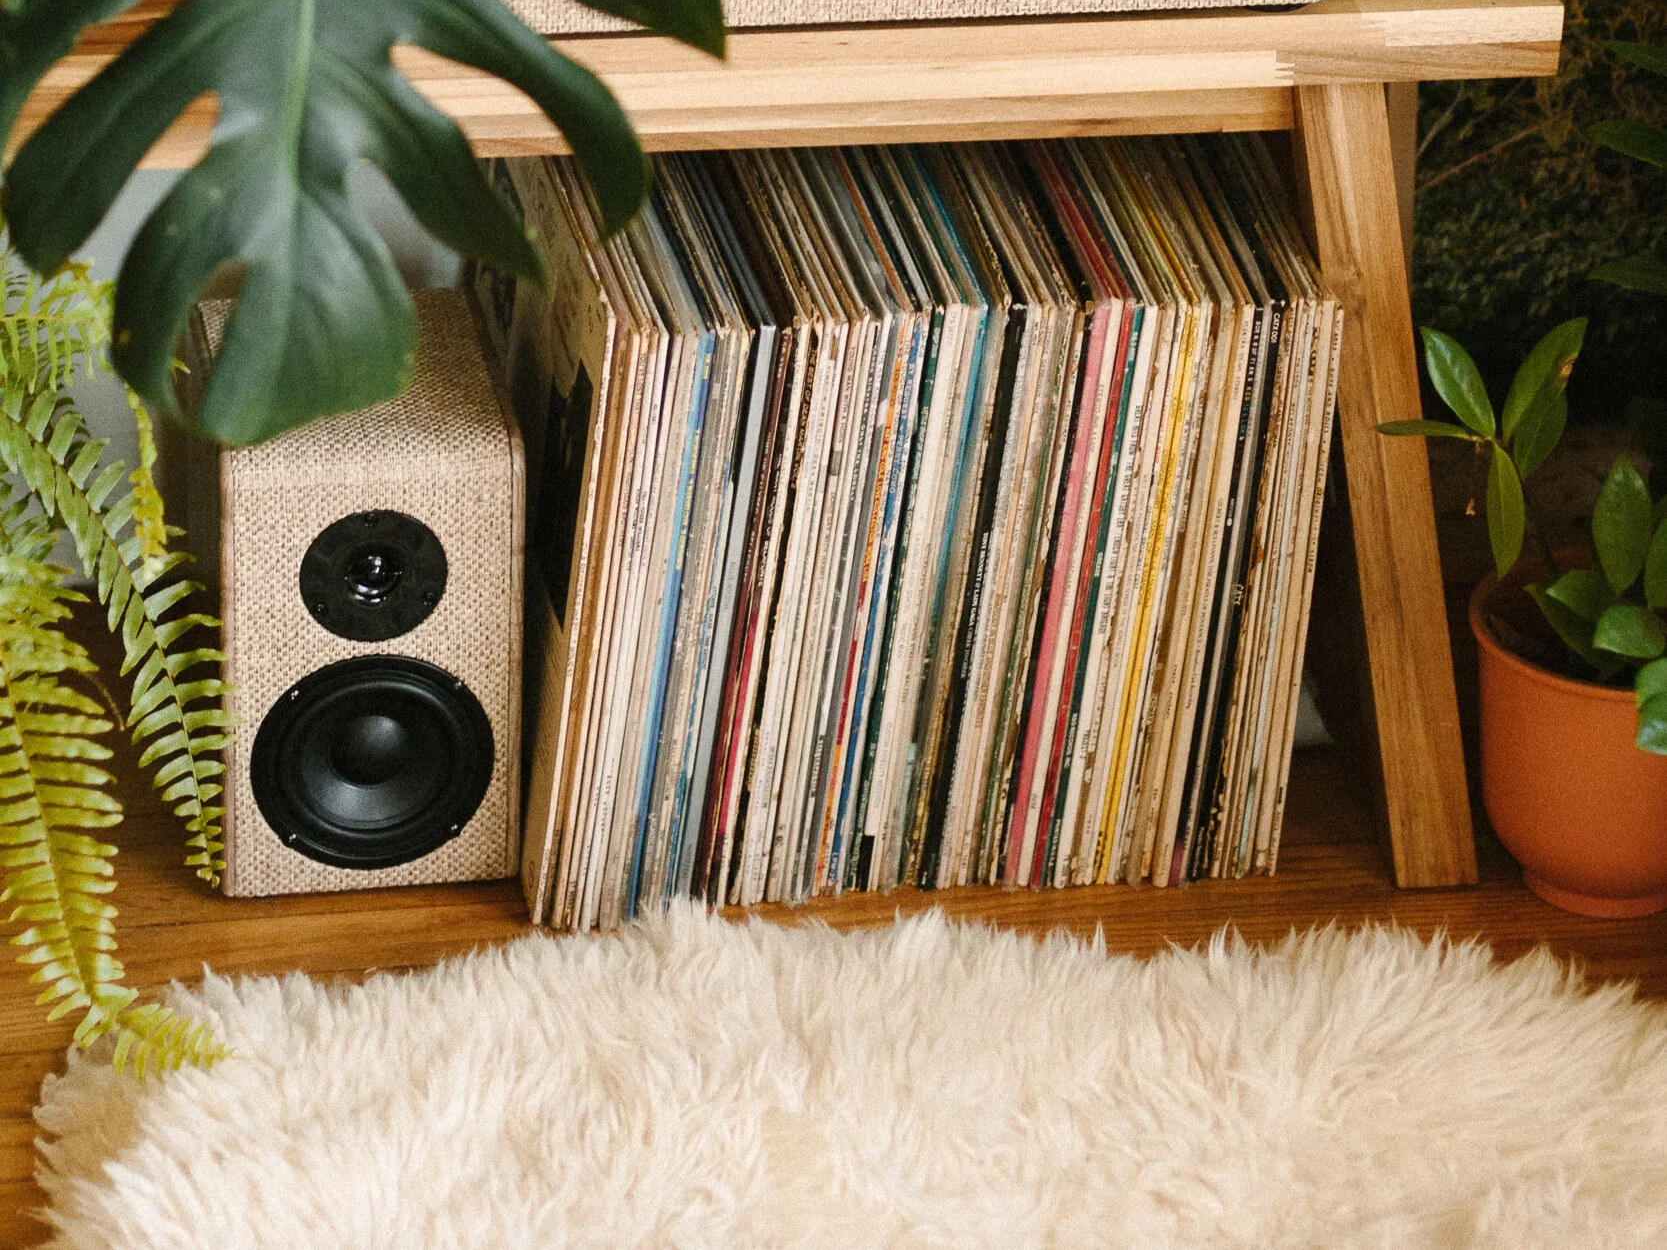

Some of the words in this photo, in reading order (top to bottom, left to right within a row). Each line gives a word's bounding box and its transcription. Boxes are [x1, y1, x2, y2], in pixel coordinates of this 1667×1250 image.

[1252, 320, 1260, 339] BORN
[1271, 313, 1280, 330] CATX
[847, 346, 855, 371] YOUNG
[907, 363, 914, 374] BY
[804, 367, 813, 387] BEST
[802, 389, 810, 400] OF
[841, 392, 849, 412] WITH
[862, 377, 872, 413] SINATRA
[895, 395, 902, 404] OF
[900, 379, 912, 419] REQUEST
[799, 403, 808, 425] DEAN
[857, 424, 865, 446] ONLY
[893, 434, 903, 464] PERRY
[849, 468, 859, 500] LONELY
[889, 468, 898, 493] COMO
[980, 532, 988, 548] TONY
[975, 550, 985, 581] BENNETT
[1093, 552, 1103, 577] GREASE
[971, 589, 979, 606] LADY
[968, 608, 976, 625] GAGA
[964, 627, 973, 647] CHEEK
[959, 657, 968, 678] CHEEK
